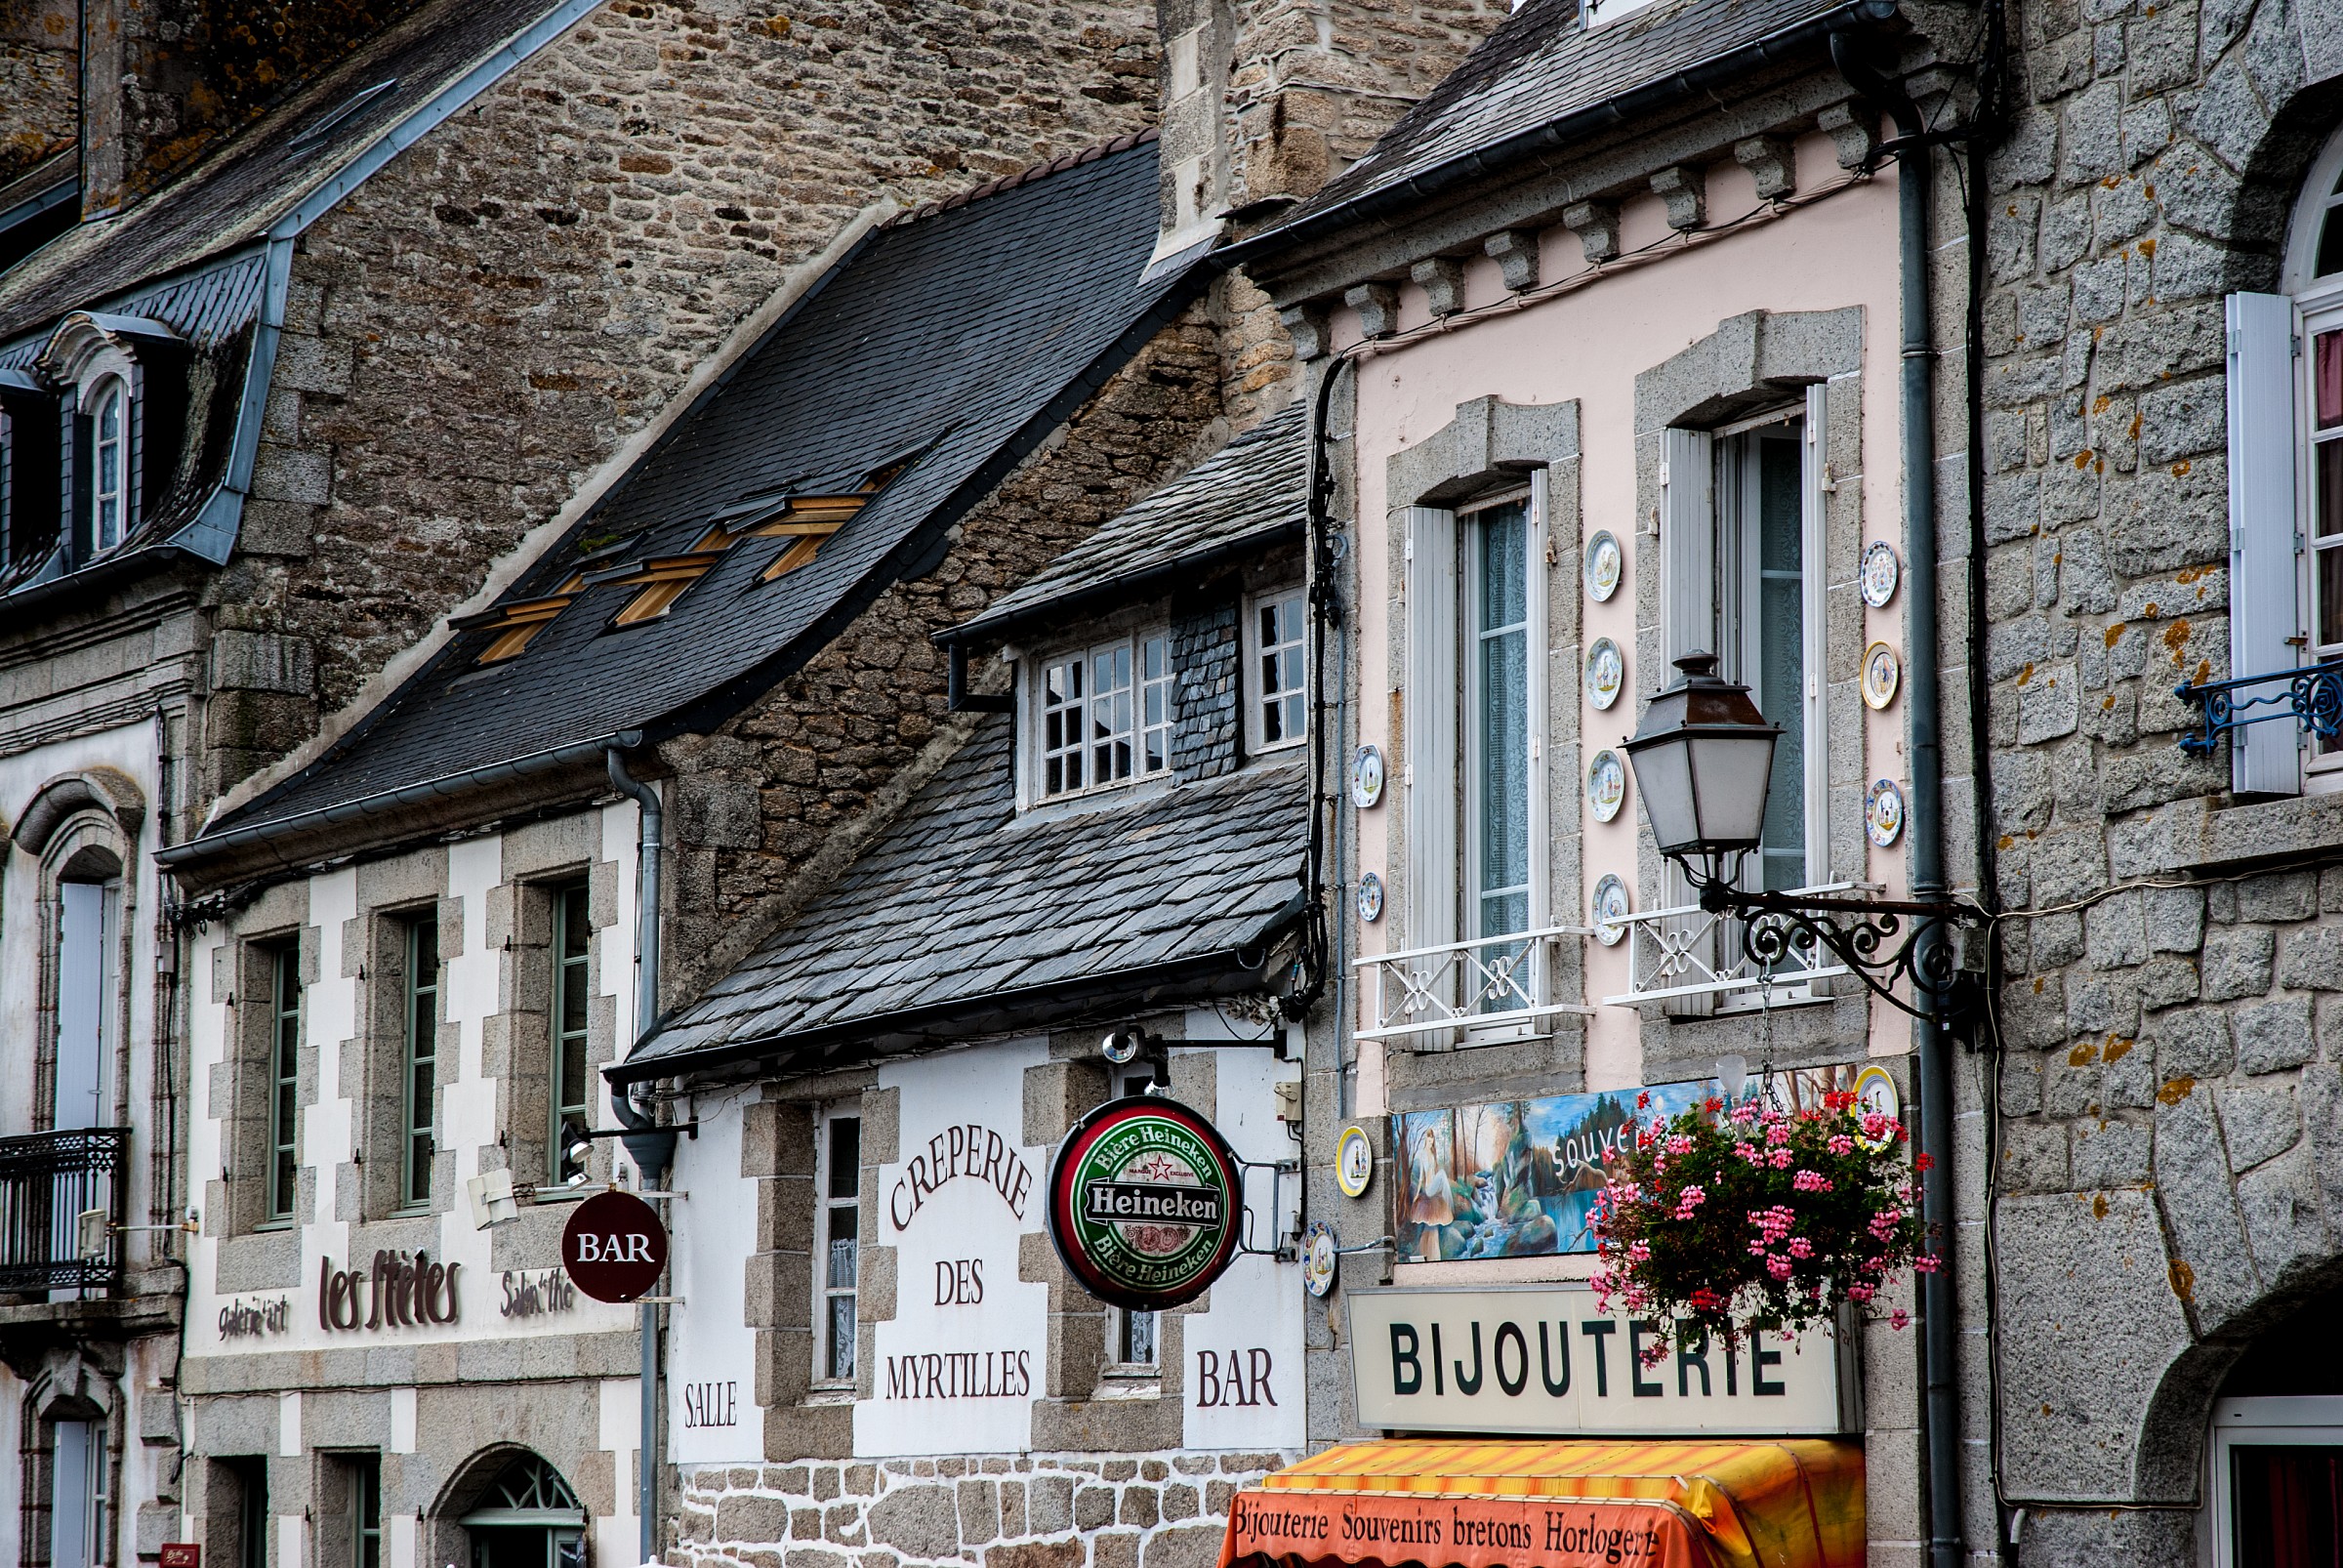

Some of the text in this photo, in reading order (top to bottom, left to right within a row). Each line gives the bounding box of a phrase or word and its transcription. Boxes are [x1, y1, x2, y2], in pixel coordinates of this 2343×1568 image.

[890, 1124, 1033, 1231] CREPERIE
[1094, 1126, 1214, 1179] Bière Heineken
[1091, 1186, 1218, 1219] Heineken
[577, 1233, 655, 1263] BAR
[1093, 1234, 1213, 1283] Bière Heineken
[319, 1256, 362, 1331] les
[500, 1270, 543, 1318] Salon
[934, 1259, 984, 1305] DES
[885, 1350, 1030, 1400] MYRTILLES
[1197, 1347, 1278, 1407] BAR
[1390, 1320, 1786, 1397] BIJOUTERIE
[685, 1381, 737, 1428] SALLE
[1237, 1499, 1660, 1564] Bijouterie Souvenirs bretons Horlogerie
